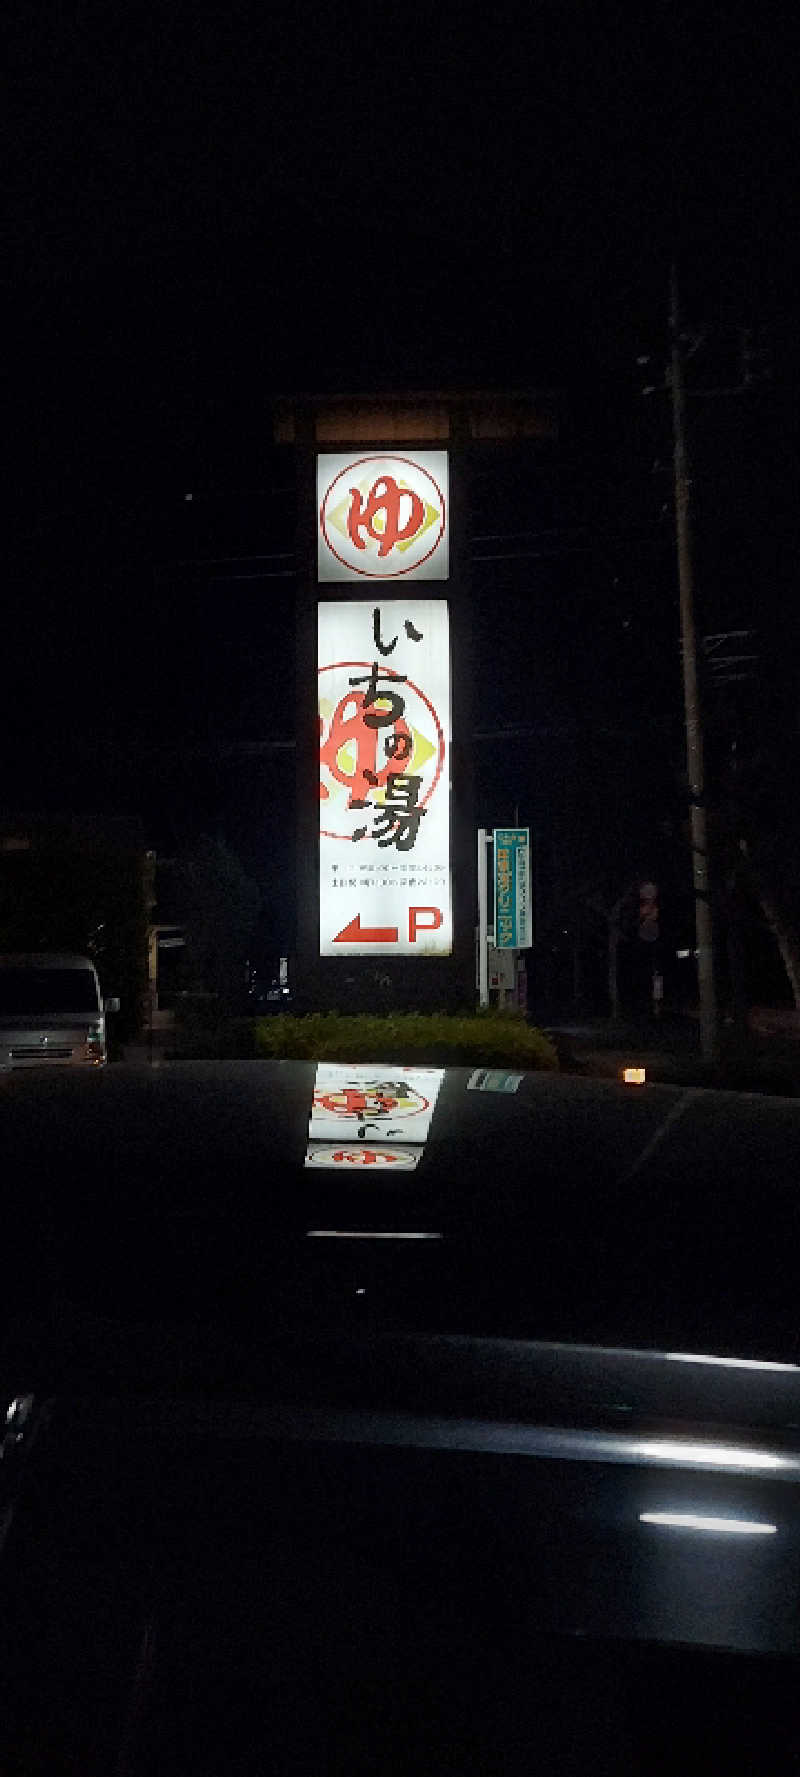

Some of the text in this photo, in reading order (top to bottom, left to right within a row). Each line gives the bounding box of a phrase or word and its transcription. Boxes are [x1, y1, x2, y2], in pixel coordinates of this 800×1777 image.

[348, 475, 425, 557] ゆ
[348, 606, 427, 852] いちの湯
[408, 906, 444, 943] P
